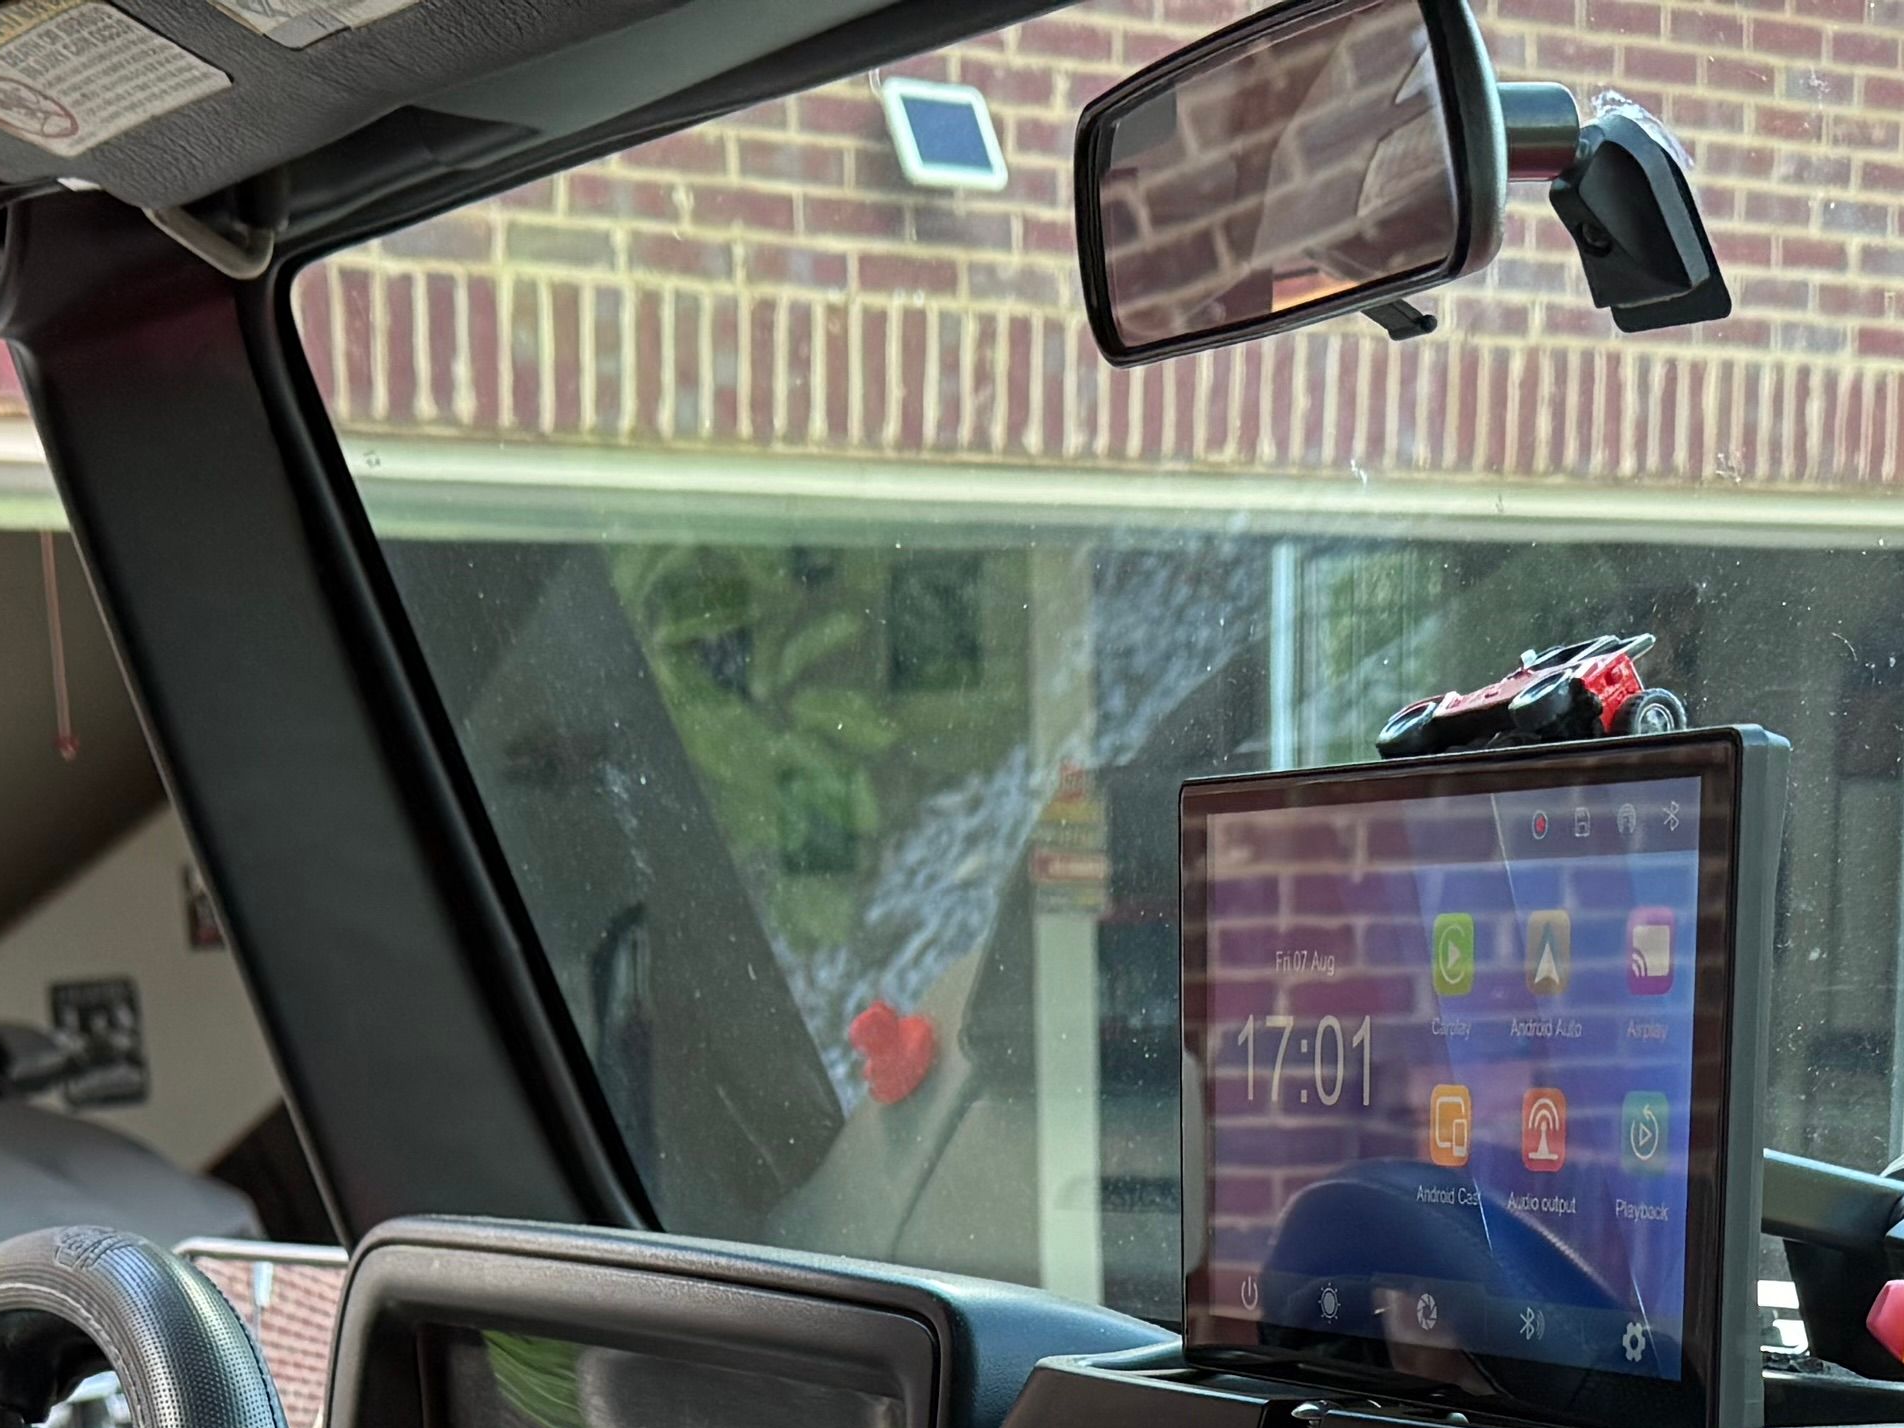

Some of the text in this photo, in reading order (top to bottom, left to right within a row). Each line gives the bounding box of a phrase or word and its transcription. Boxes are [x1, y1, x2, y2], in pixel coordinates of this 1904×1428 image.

[1275, 950, 1336, 977] Fri 07 Aug
[1510, 1019, 1583, 1038] Android Auto
[1237, 1013, 1372, 1107] 17:01
[1416, 1185, 1481, 1207] Android Cas
[1507, 1191, 1577, 1216] Audio output
[1615, 1198, 1669, 1223] Playback
